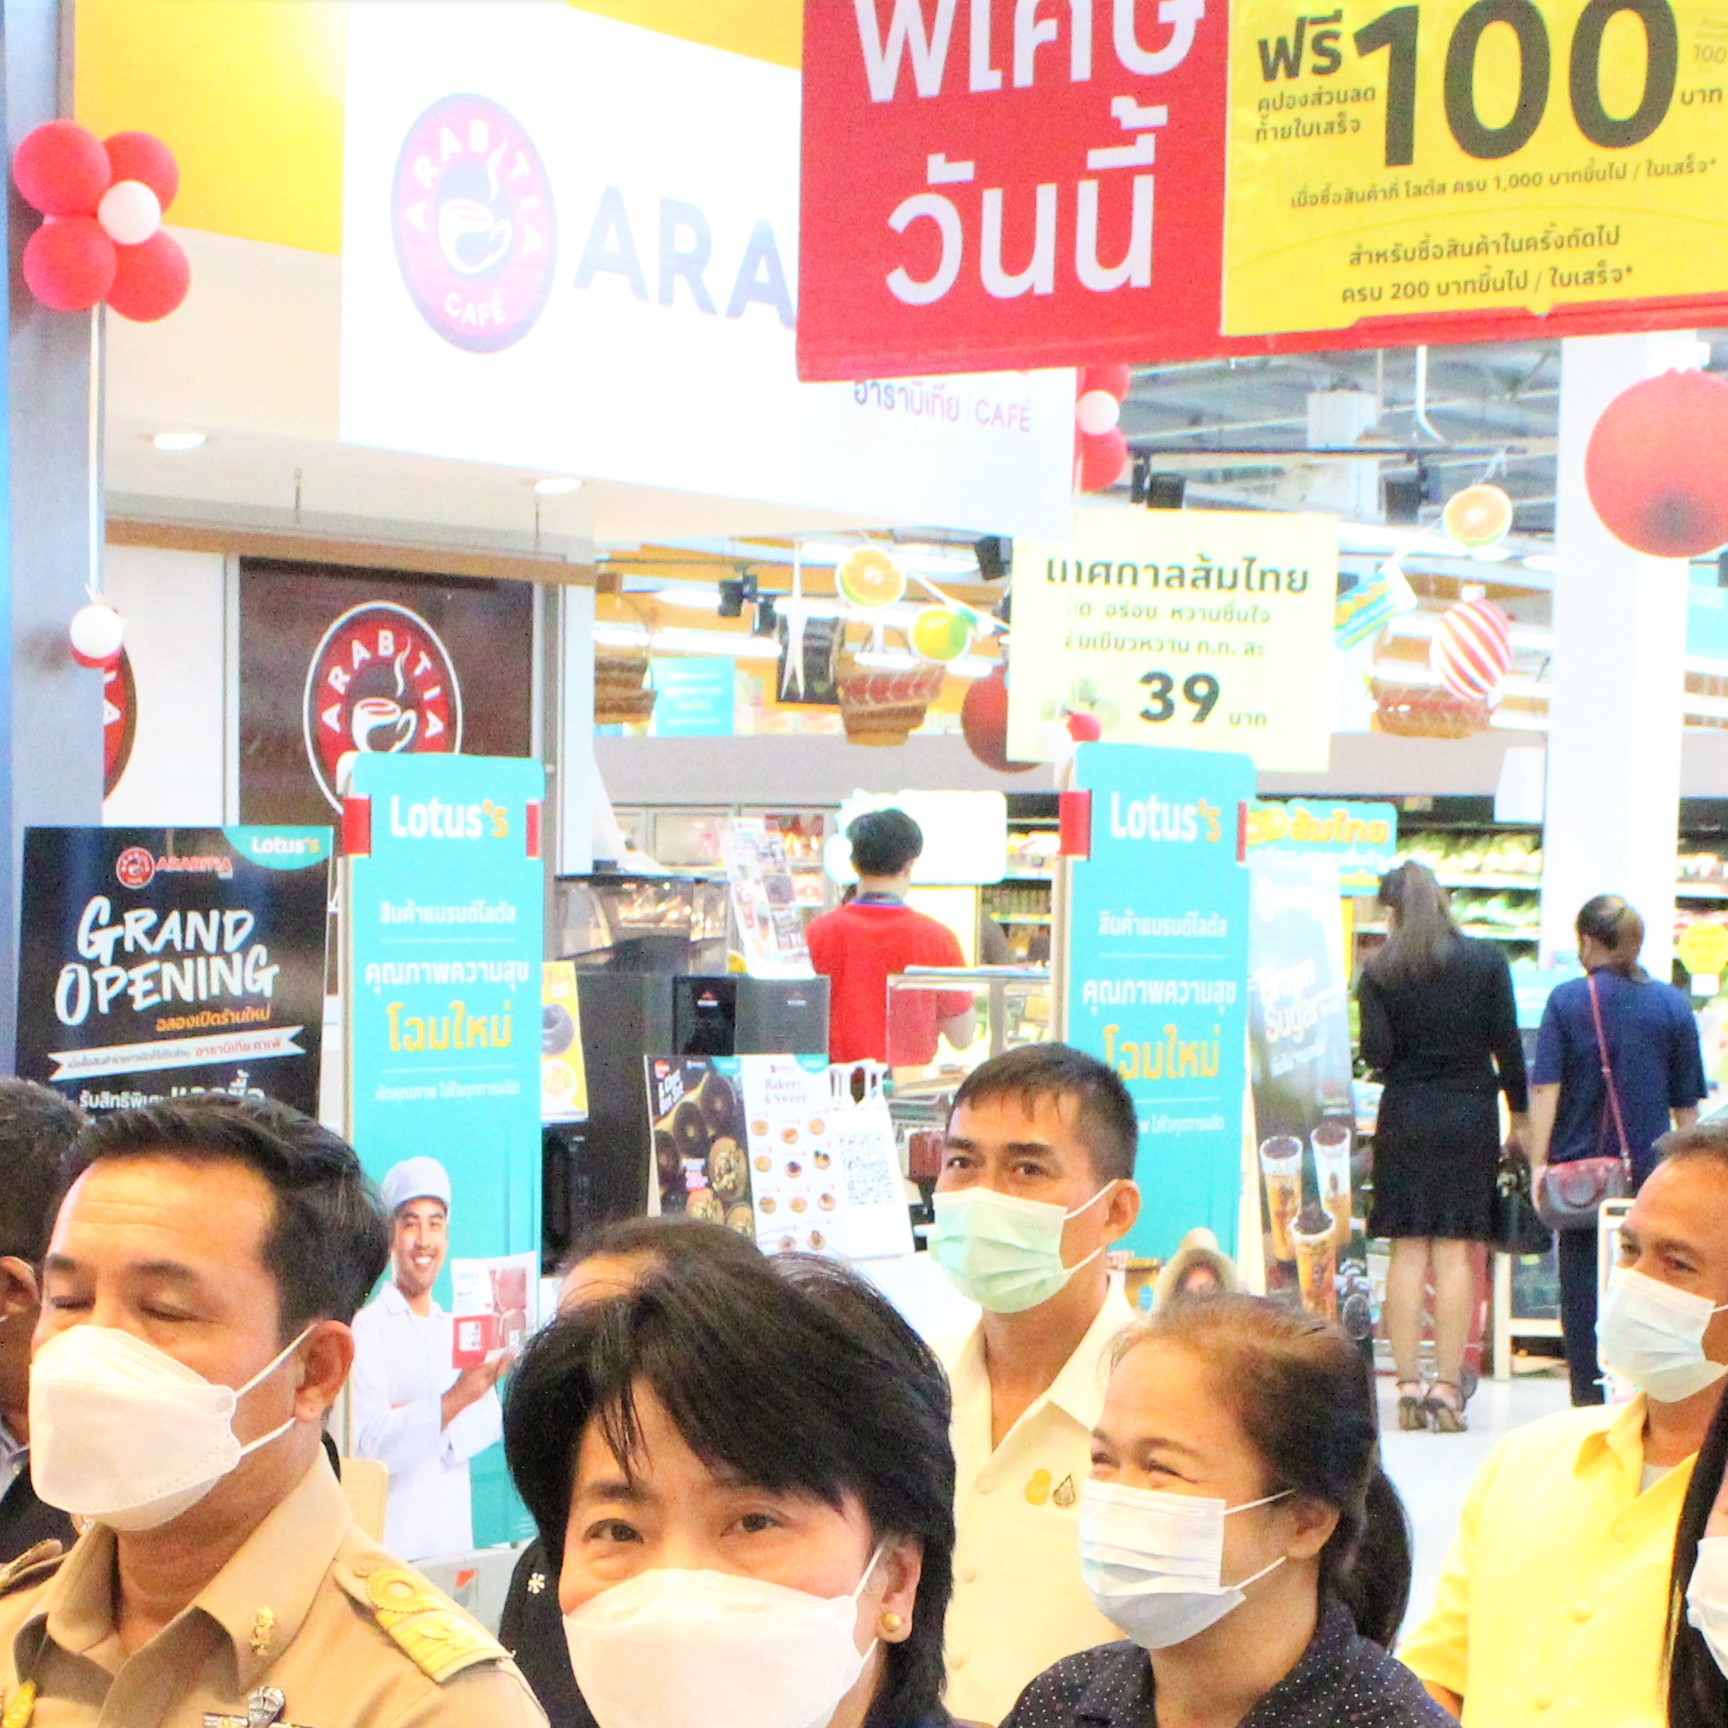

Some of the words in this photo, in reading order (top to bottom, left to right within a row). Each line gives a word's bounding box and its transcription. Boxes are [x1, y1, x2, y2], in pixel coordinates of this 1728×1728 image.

[1257, 8, 1344, 83] ฟรี
[1256, 84, 1376, 119] คูปองส่วนลด
[1353, 0, 1679, 168] 100
[1680, 86, 1724, 106] บาท
[885, 95, 1169, 307] วันนี้
[1452, 177, 1488, 195] ครบ
[1493, 171, 1544, 193] 1,000
[1341, 286, 1383, 304] ครบ
[1390, 282, 1430, 301] 200
[974, 397, 1032, 433] CAFÉ
[321, 629, 444, 738] ARABITIA
[1138, 670, 1221, 724] 39
[389, 794, 509, 840] Lotus's
[1110, 790, 1222, 843] Lotus's
[251, 836, 320, 855] Lotus's
[77, 895, 255, 967] GRAND
[54, 943, 280, 1026] OPENING
[364, 960, 530, 997] คุณภาพความสุข
[1082, 977, 1238, 1017] คุณภาพความสุข
[386, 999, 513, 1052] โฉมใหม่
[1103, 1023, 1222, 1080] โฉมใหม่
